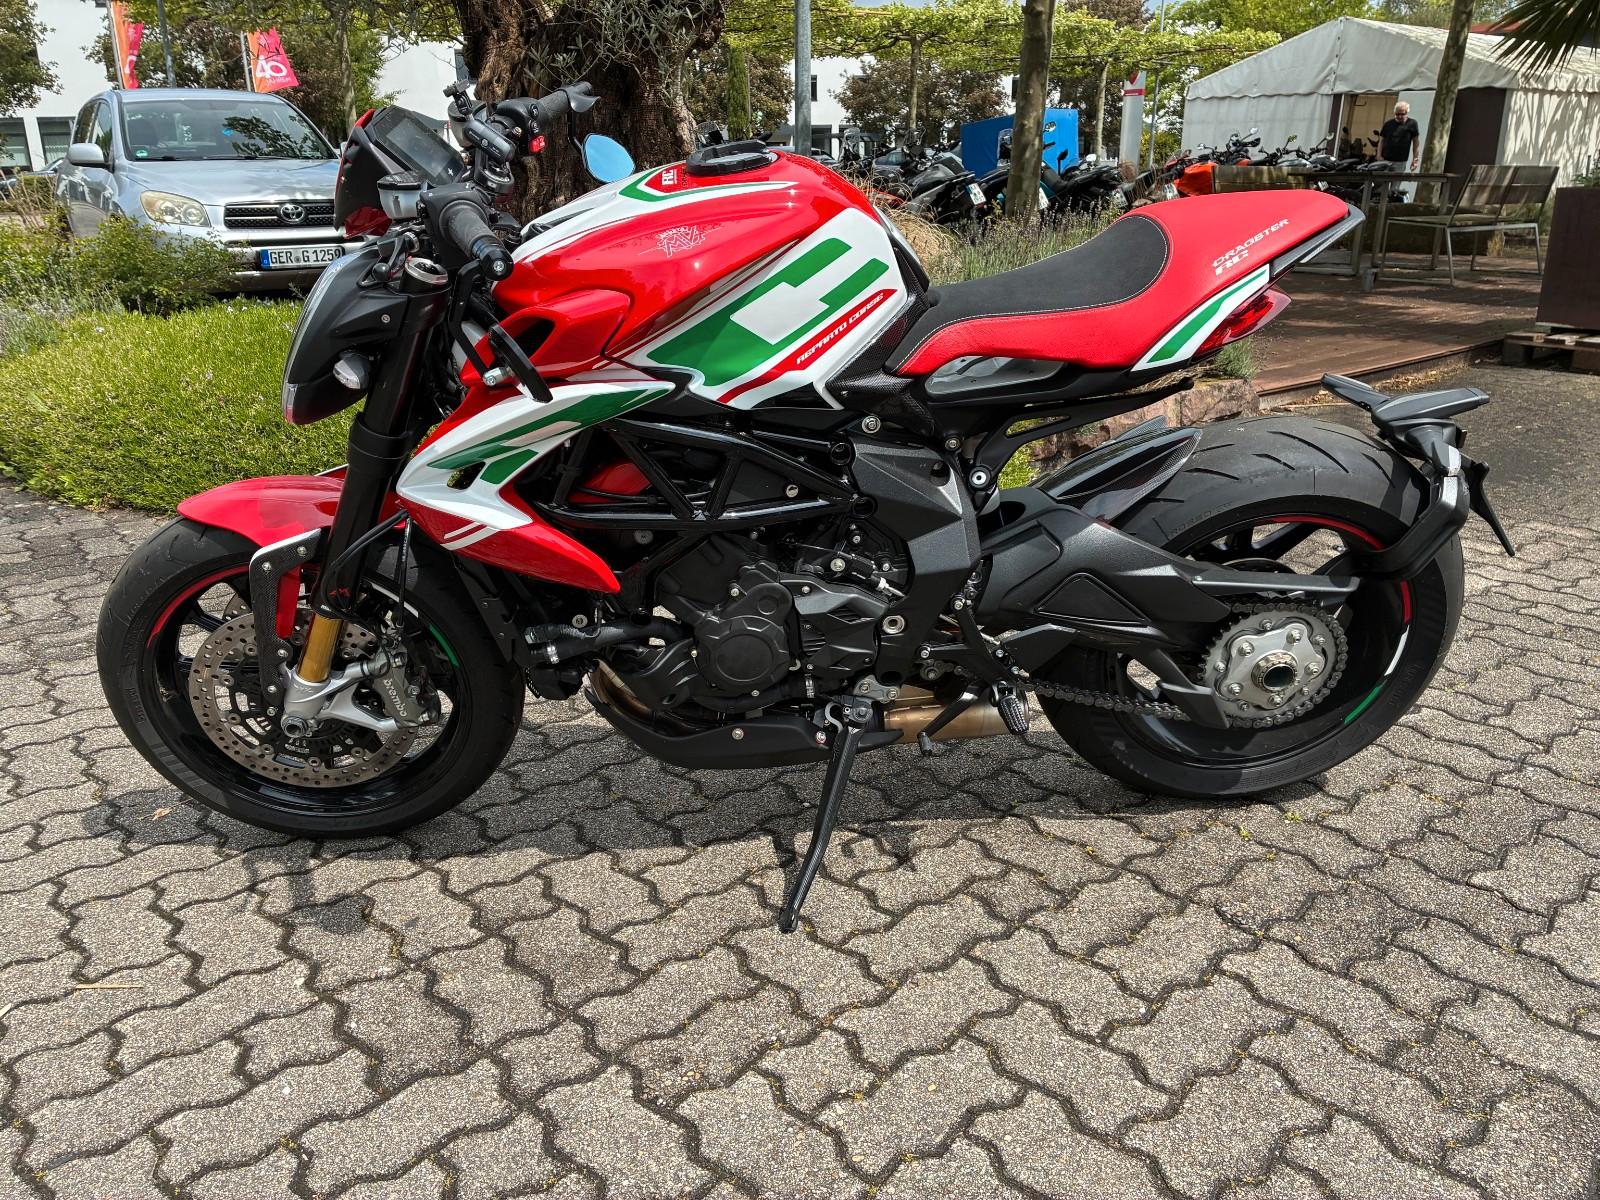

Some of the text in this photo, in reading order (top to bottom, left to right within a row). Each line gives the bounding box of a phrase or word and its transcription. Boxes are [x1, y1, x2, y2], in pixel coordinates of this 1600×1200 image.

[256, 55, 288, 78] 40
[661, 168, 675, 186] RC
[1212, 218, 1290, 267] DRAGSTER
[269, 249, 293, 265] GER
[301, 249, 311, 263] G
[1215, 249, 1249, 276] RC
[796, 292, 884, 365] REPARTO CORSE
[383, 678, 407, 717] brembo
